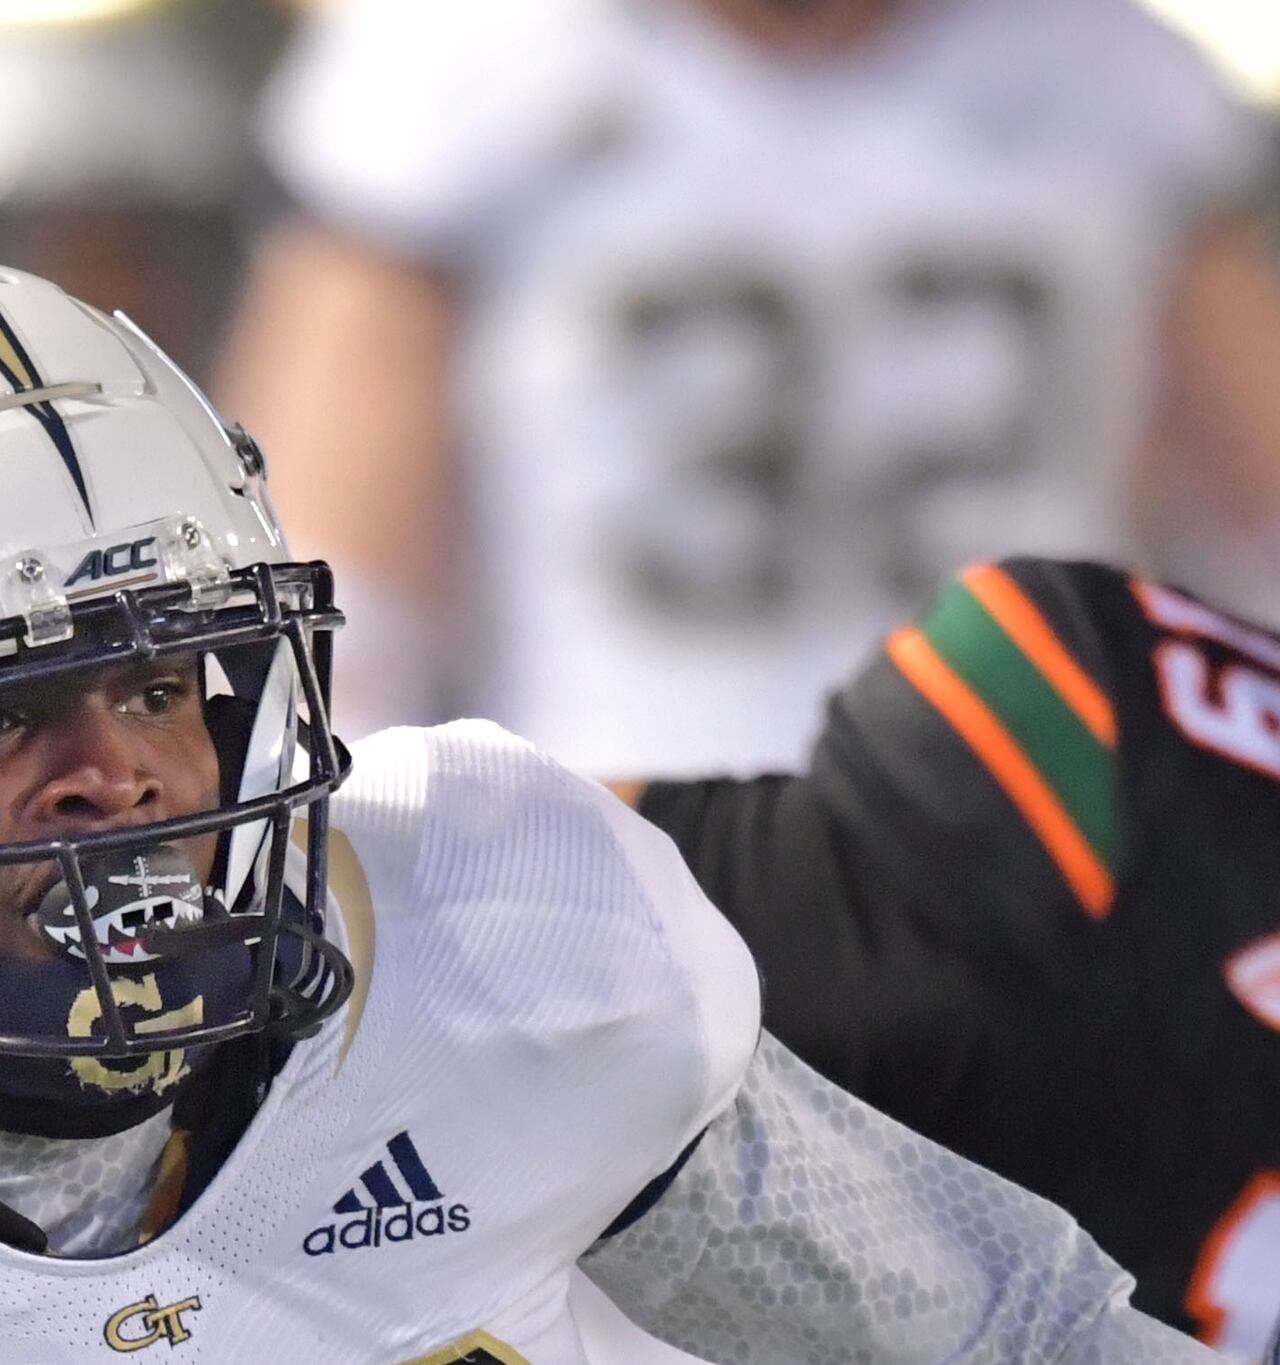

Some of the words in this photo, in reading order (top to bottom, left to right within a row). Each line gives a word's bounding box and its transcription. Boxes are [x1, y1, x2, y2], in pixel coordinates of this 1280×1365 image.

[600, 248, 1055, 630] 32
[63, 536, 158, 587] ACC
[302, 1200, 472, 1256] adidas
[103, 1293, 202, 1353] GT
